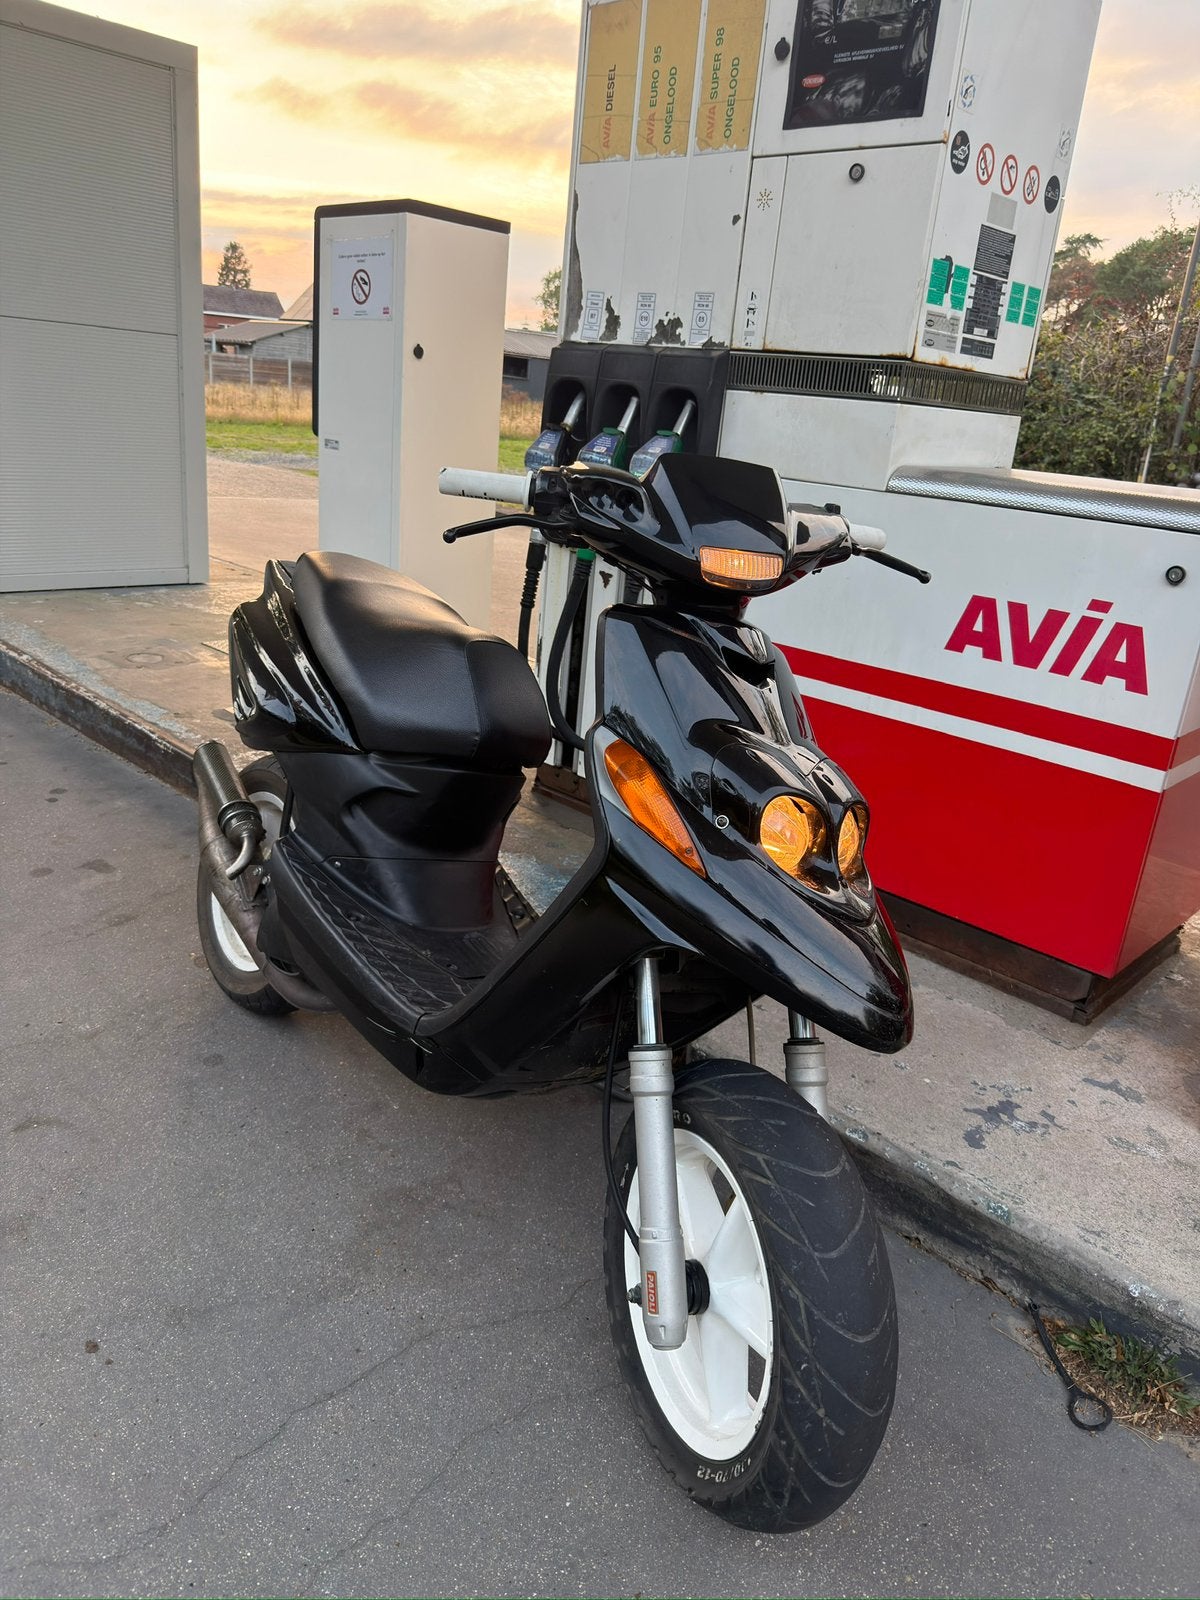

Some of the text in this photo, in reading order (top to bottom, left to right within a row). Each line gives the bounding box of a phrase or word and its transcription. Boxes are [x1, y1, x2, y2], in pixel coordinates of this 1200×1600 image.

[653, 45, 662, 64] 95
[715, 27, 725, 46] 98
[605, 64, 617, 112] DIESEL
[649, 69, 660, 108] EURO
[710, 52, 722, 100] SUPER
[663, 66, 678, 145] ONGELOOD
[723, 57, 740, 139] ONGELOOD
[647, 1274, 656, 1313] PAIOLI
